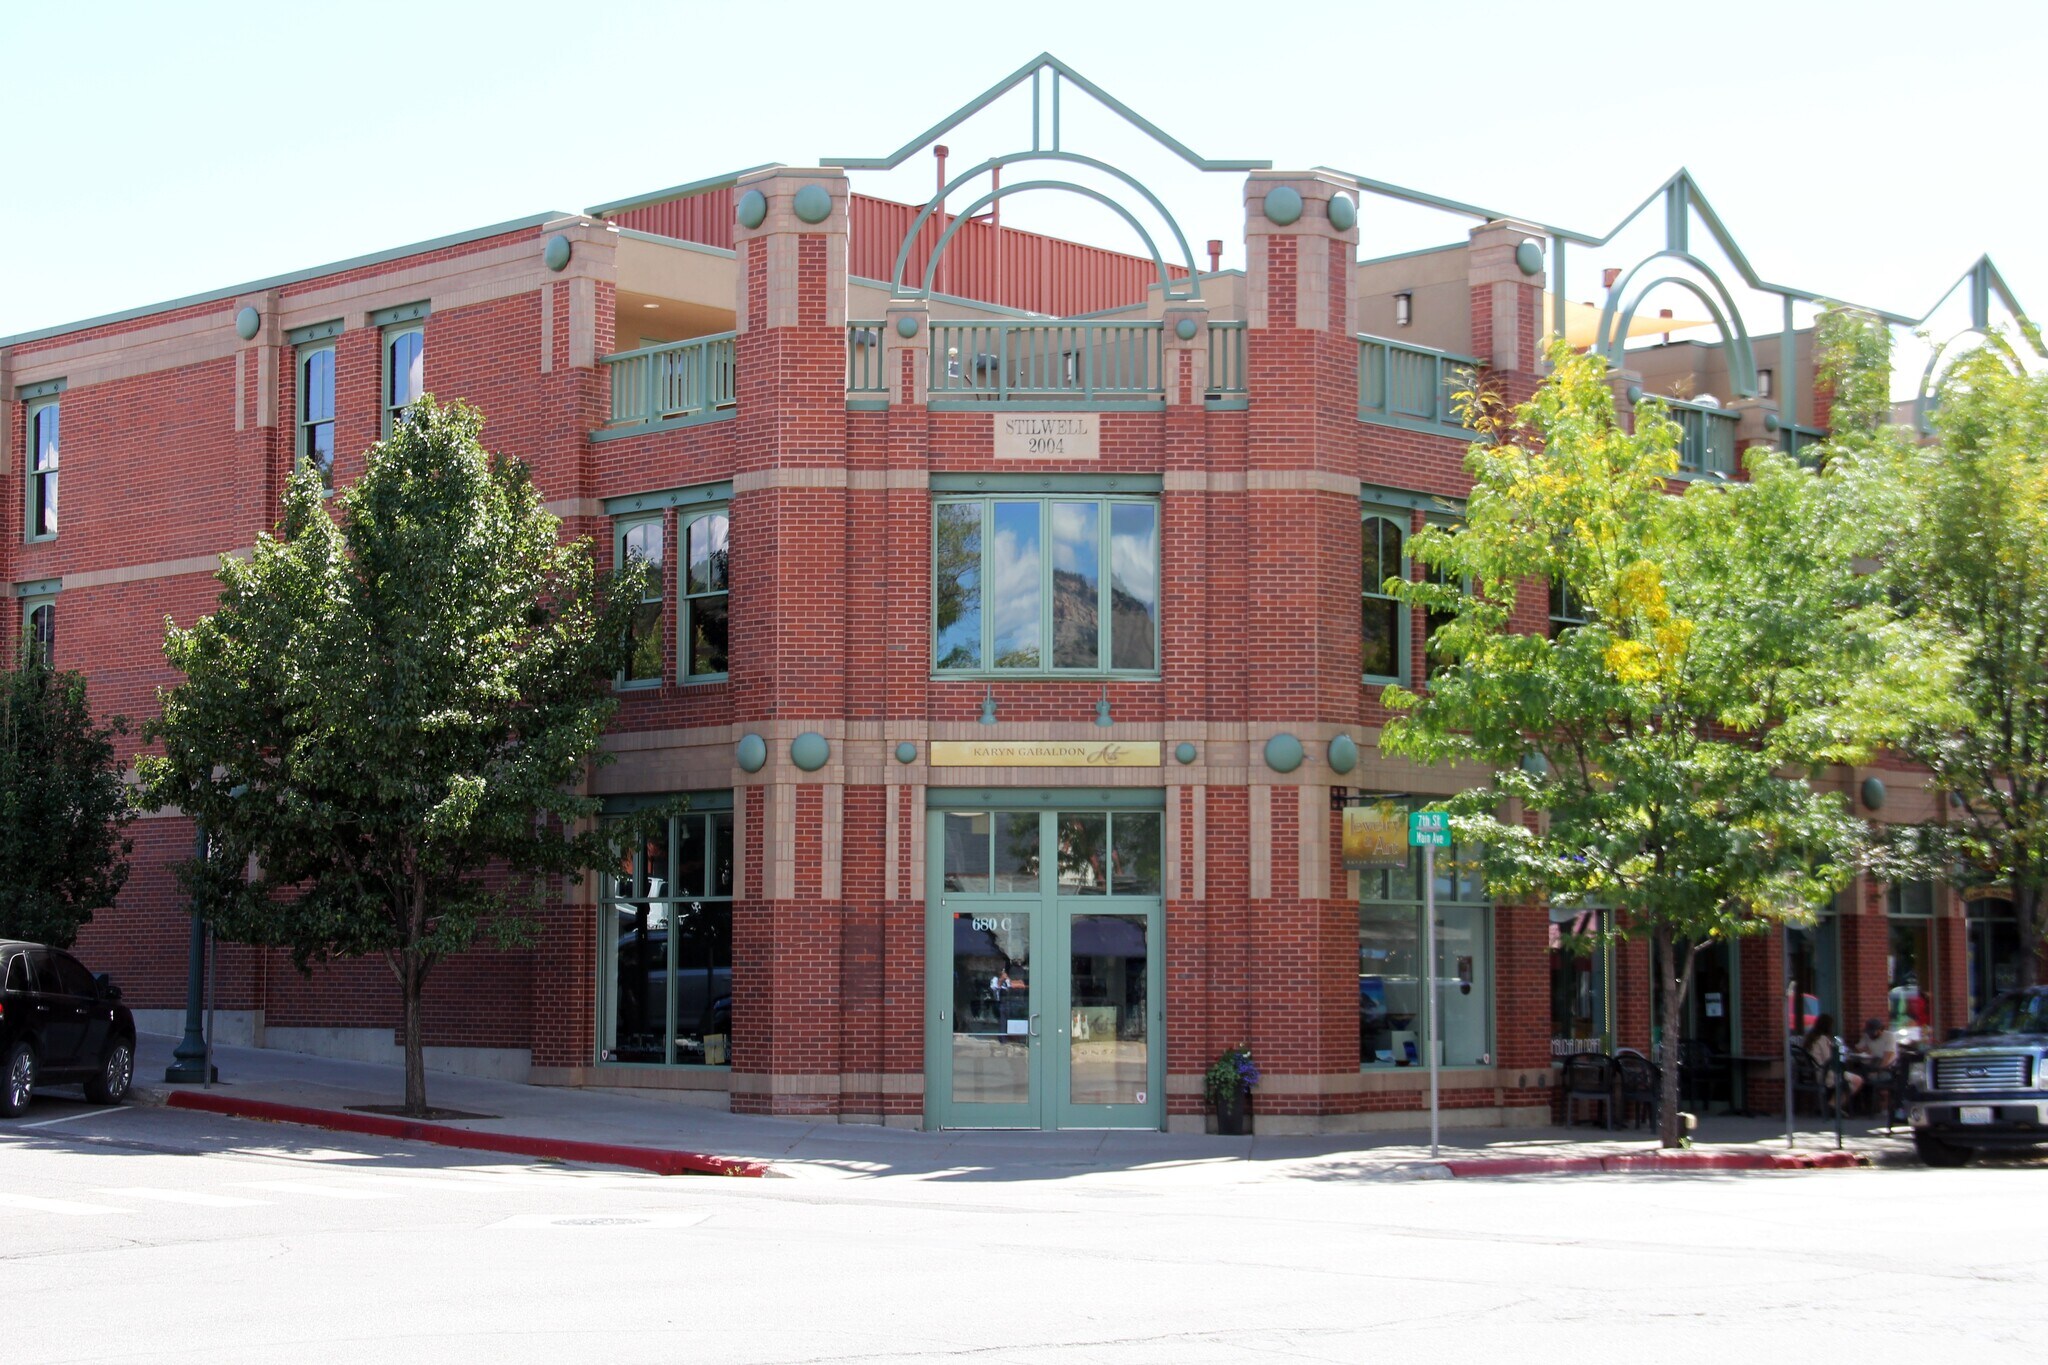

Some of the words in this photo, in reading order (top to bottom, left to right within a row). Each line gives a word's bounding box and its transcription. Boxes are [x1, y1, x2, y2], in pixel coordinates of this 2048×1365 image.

[1006, 419, 1088, 435] STILWELL
[1028, 438, 1065, 454] 2004
[974, 747, 1014, 757] KARYN
[1018, 747, 1085, 757] GABALDON
[1418, 814, 1430, 827] 7th
[1432, 814, 1441, 827] St
[1416, 831, 1431, 844] Main
[1432, 832, 1444, 844] Ave
[973, 917, 998, 931] 680
[1001, 917, 1012, 931] C
